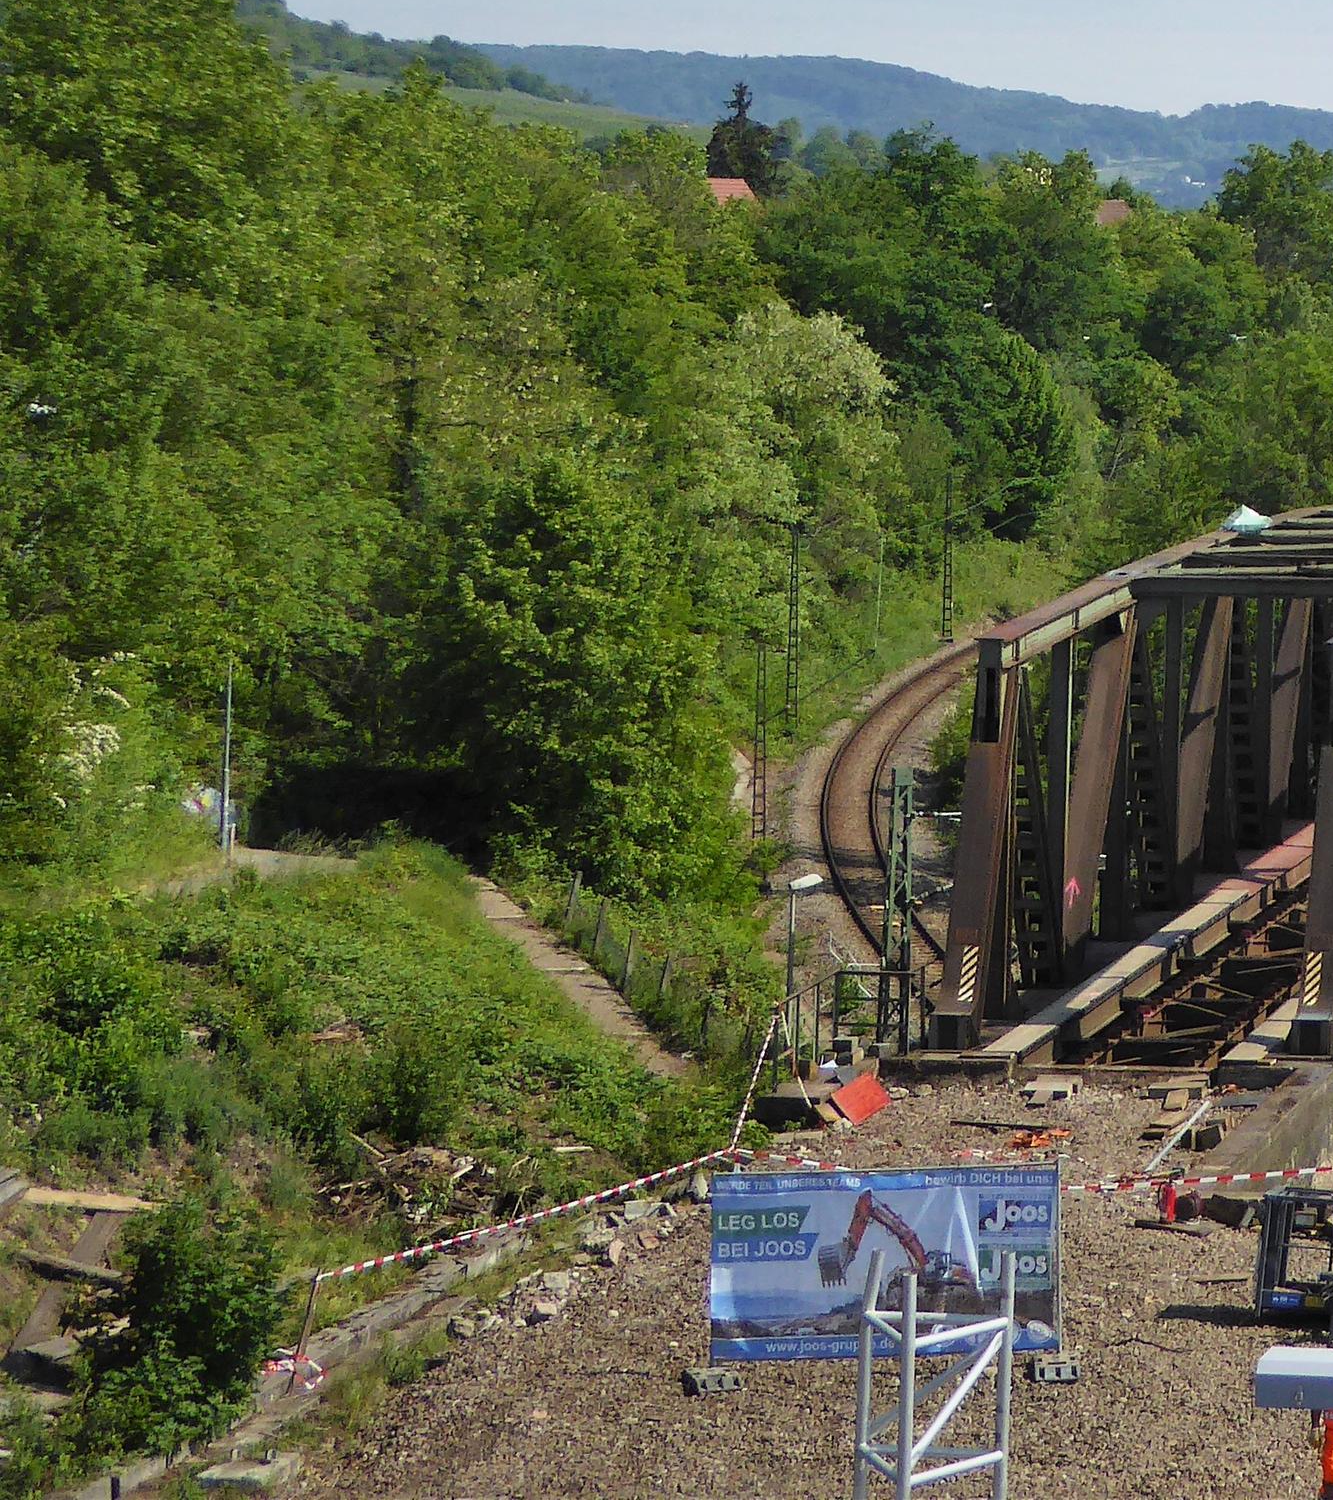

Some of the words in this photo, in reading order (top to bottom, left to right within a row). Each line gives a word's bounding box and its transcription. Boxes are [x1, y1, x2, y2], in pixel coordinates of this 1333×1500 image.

[969, 1172, 1001, 1184] DICH
[1004, 1172, 1023, 1183] bei
[718, 1214, 755, 1231] LEG
[761, 1212, 800, 1229] LOS
[717, 1242, 748, 1258] BEI
[754, 1240, 807, 1257] JOOS
[980, 1249, 1048, 1282] Jos
[765, 1339, 896, 1354] www.joos-grup.de
